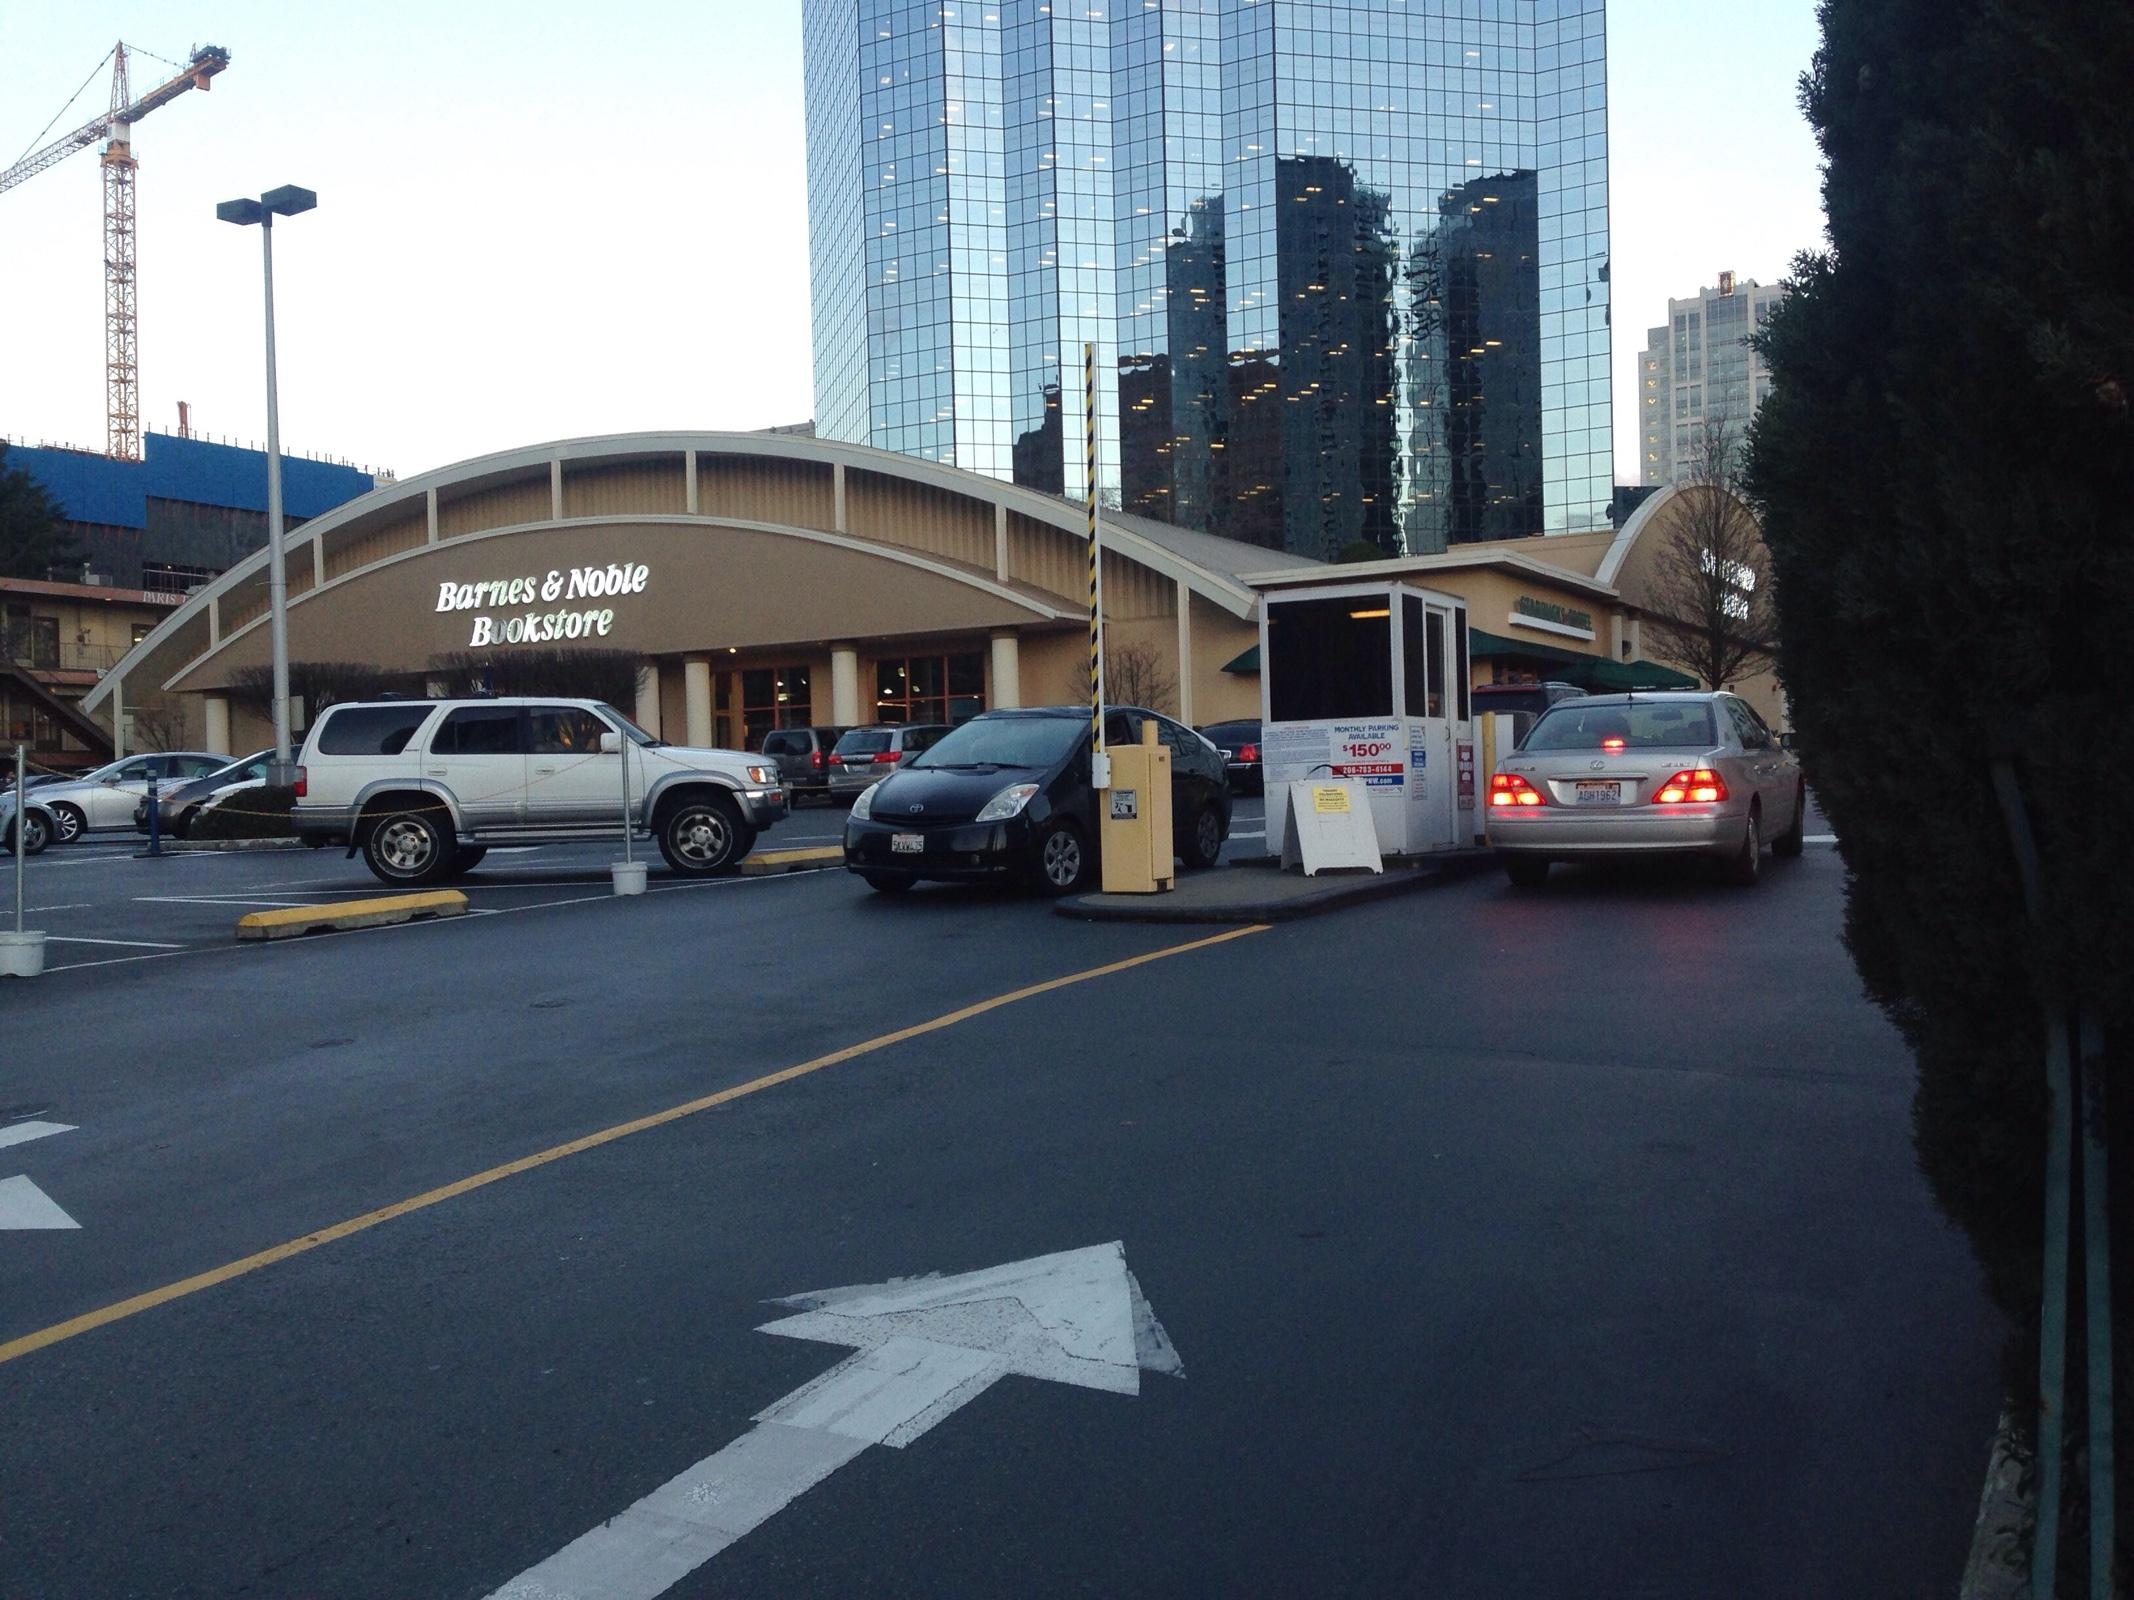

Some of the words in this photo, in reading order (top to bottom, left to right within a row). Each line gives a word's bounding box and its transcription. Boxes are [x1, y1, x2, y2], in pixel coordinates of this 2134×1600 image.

[435, 577, 536, 612] Barnes
[541, 570, 564, 601] &
[565, 562, 649, 599] Noble
[143, 591, 177, 605] PARIS
[469, 608, 614, 647] Bookstore
[1368, 724, 1399, 732] PARKING
[1348, 732, 1386, 740] AVAILABLE
